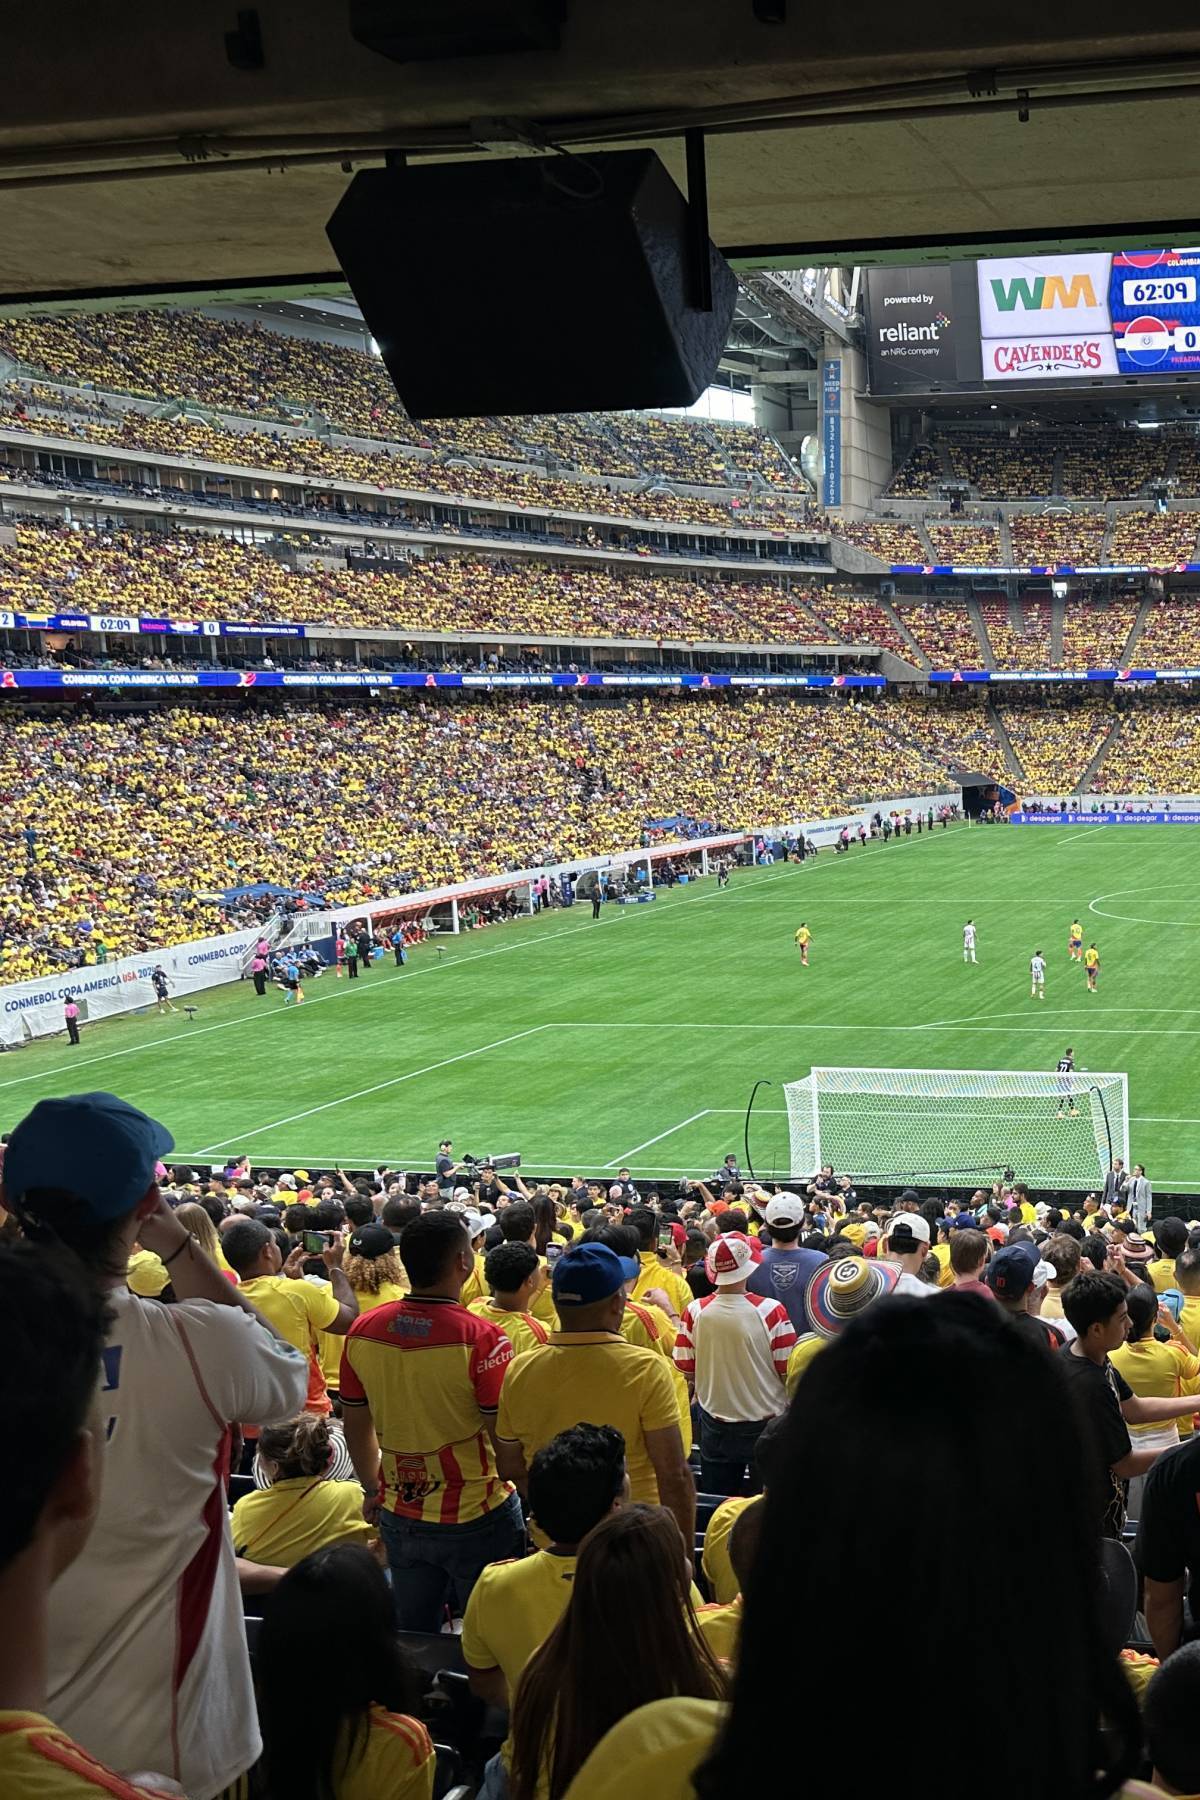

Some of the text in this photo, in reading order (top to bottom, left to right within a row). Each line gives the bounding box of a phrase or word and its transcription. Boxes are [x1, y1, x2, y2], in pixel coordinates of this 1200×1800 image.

[990, 273, 1098, 312] WM
[1133, 282, 1188, 302] 62:09
[884, 293, 934, 306] powered by
[879, 322, 940, 343] reliant
[1184, 331, 1196, 348] 0
[880, 348, 891, 356] an
[908, 346, 940, 357] company
[993, 341, 1102, 373] CAVENDER'S
[1, 613, 9, 625] 2
[99, 618, 131, 631] 62:09
[208, 623, 215, 633] 0
[1029, 814, 1062, 823] despegar
[1076, 814, 1110, 823] despegar
[1124, 814, 1157, 823] despegar
[188, 950, 228, 966] CONMEBOL
[5, 992, 57, 1013] CONMEBOL
[58, 985, 82, 1000] COPA
[83, 975, 122, 993] AMERICA
[122, 971, 137, 984] USA
